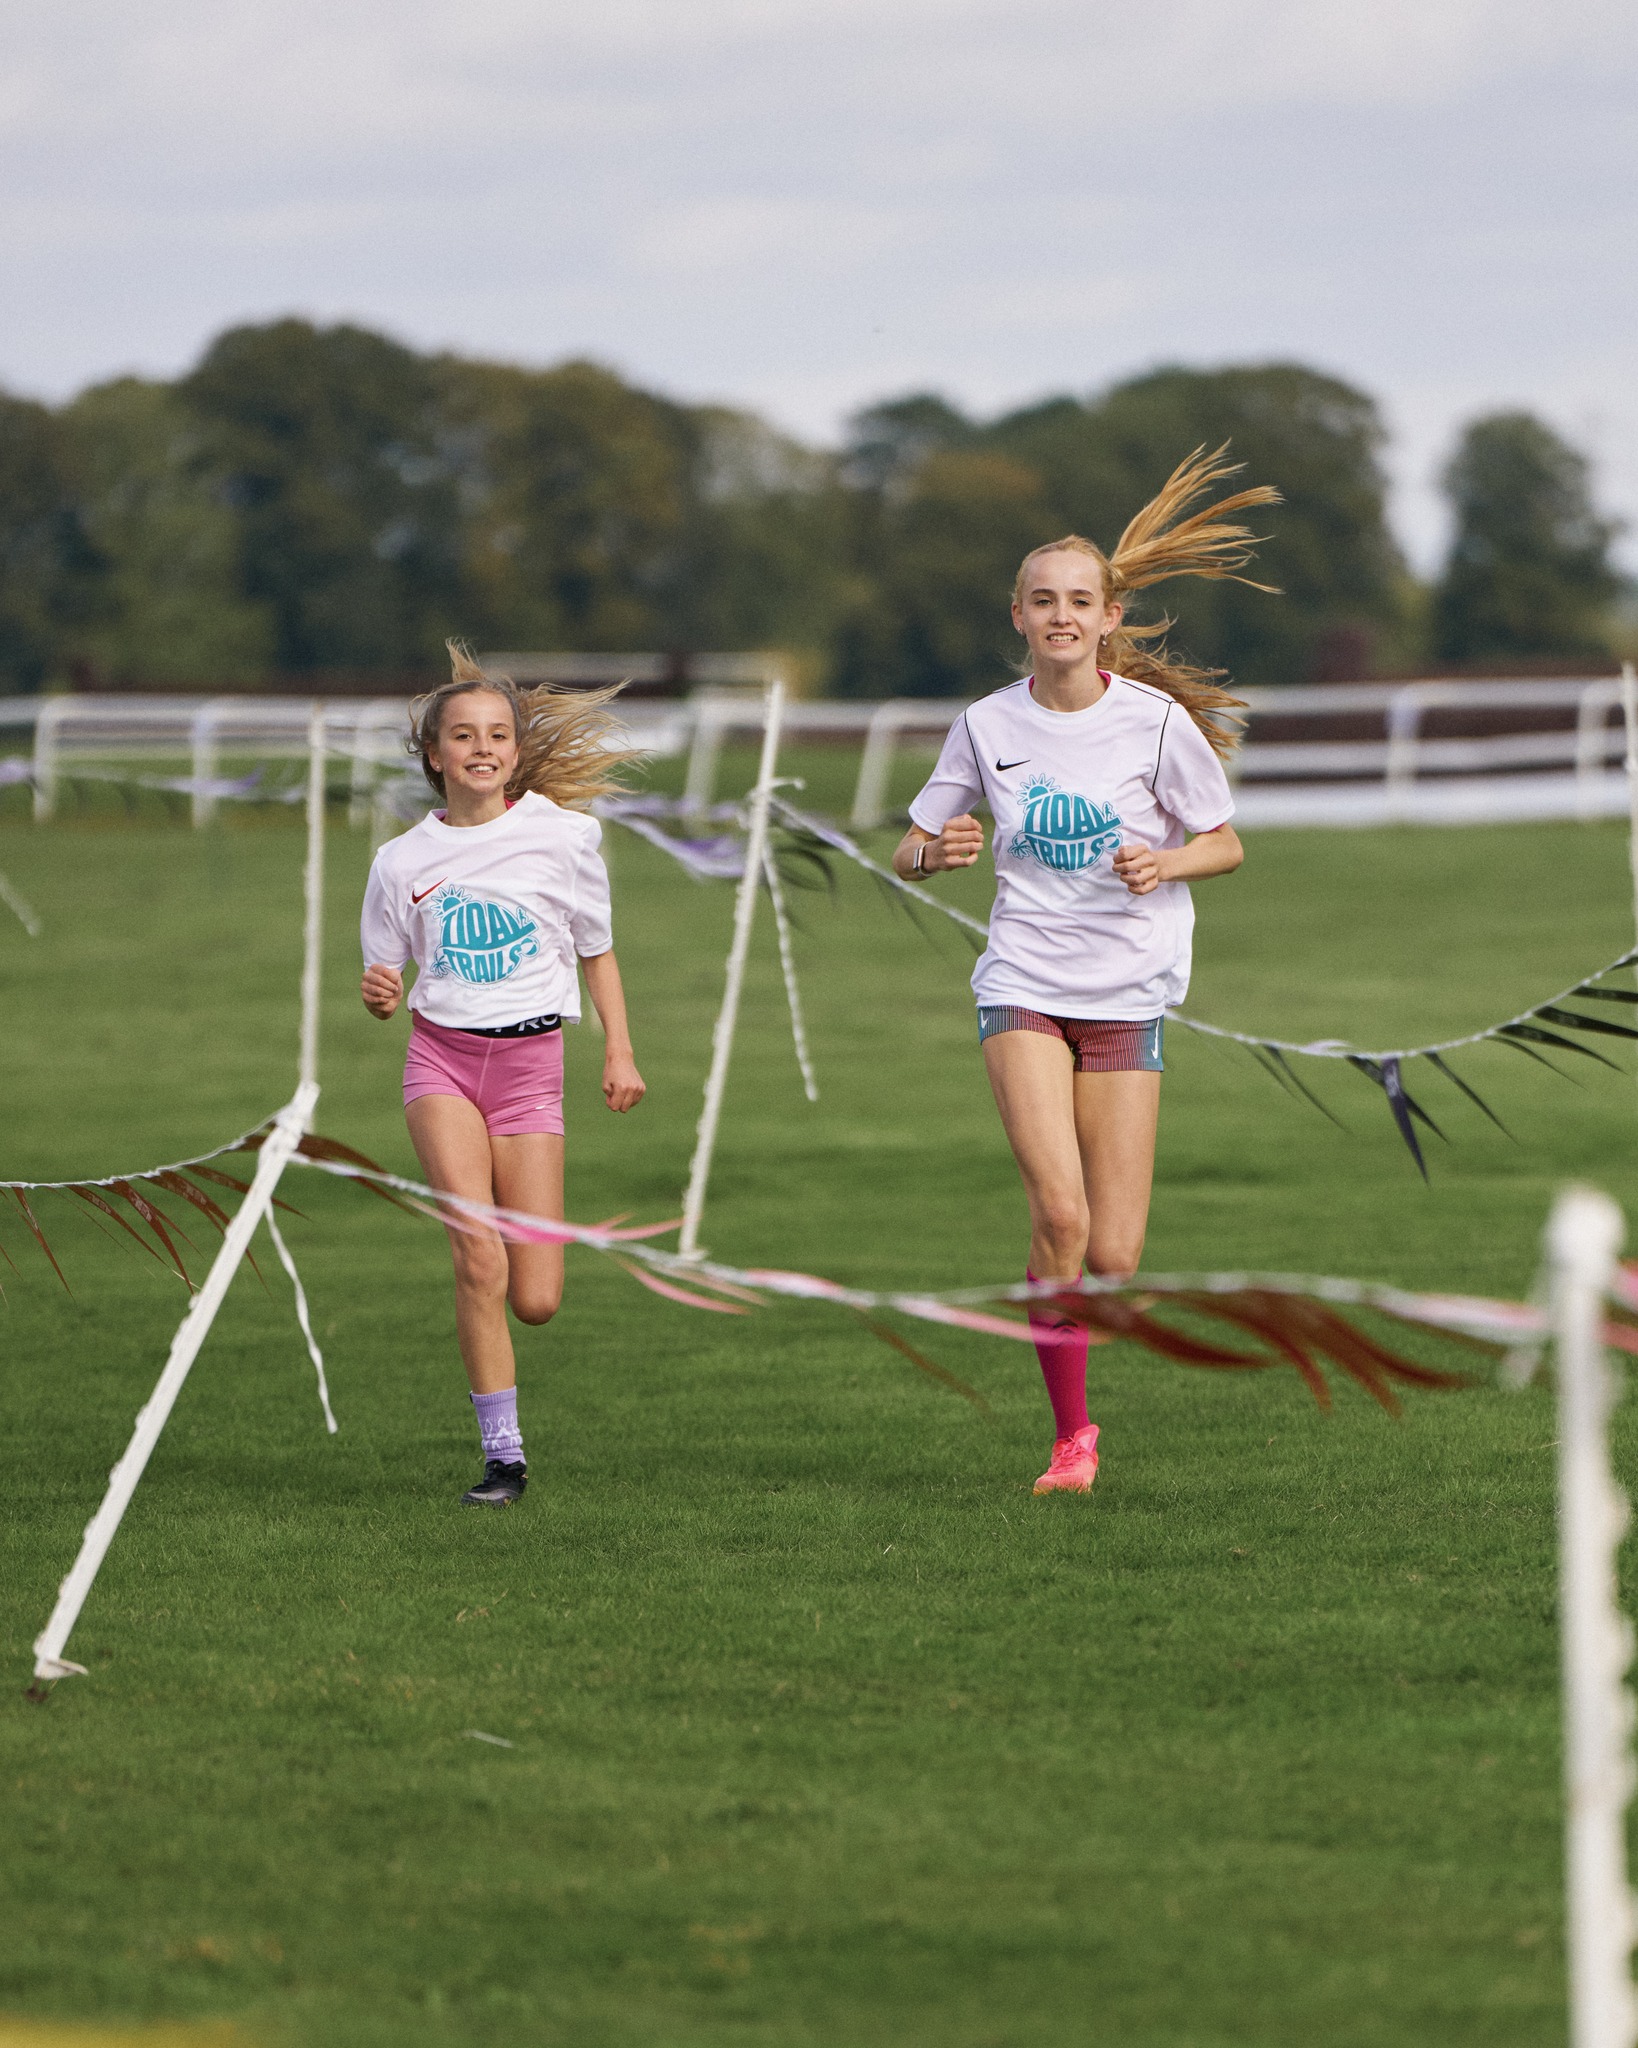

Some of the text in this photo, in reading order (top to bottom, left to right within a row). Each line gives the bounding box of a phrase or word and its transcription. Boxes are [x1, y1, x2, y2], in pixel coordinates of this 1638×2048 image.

[1024, 793, 1121, 841] TIDAL
[1024, 834, 1104, 871] TRAILS
[442, 902, 537, 951] TIDAL
[442, 944, 522, 983] TRAILS
